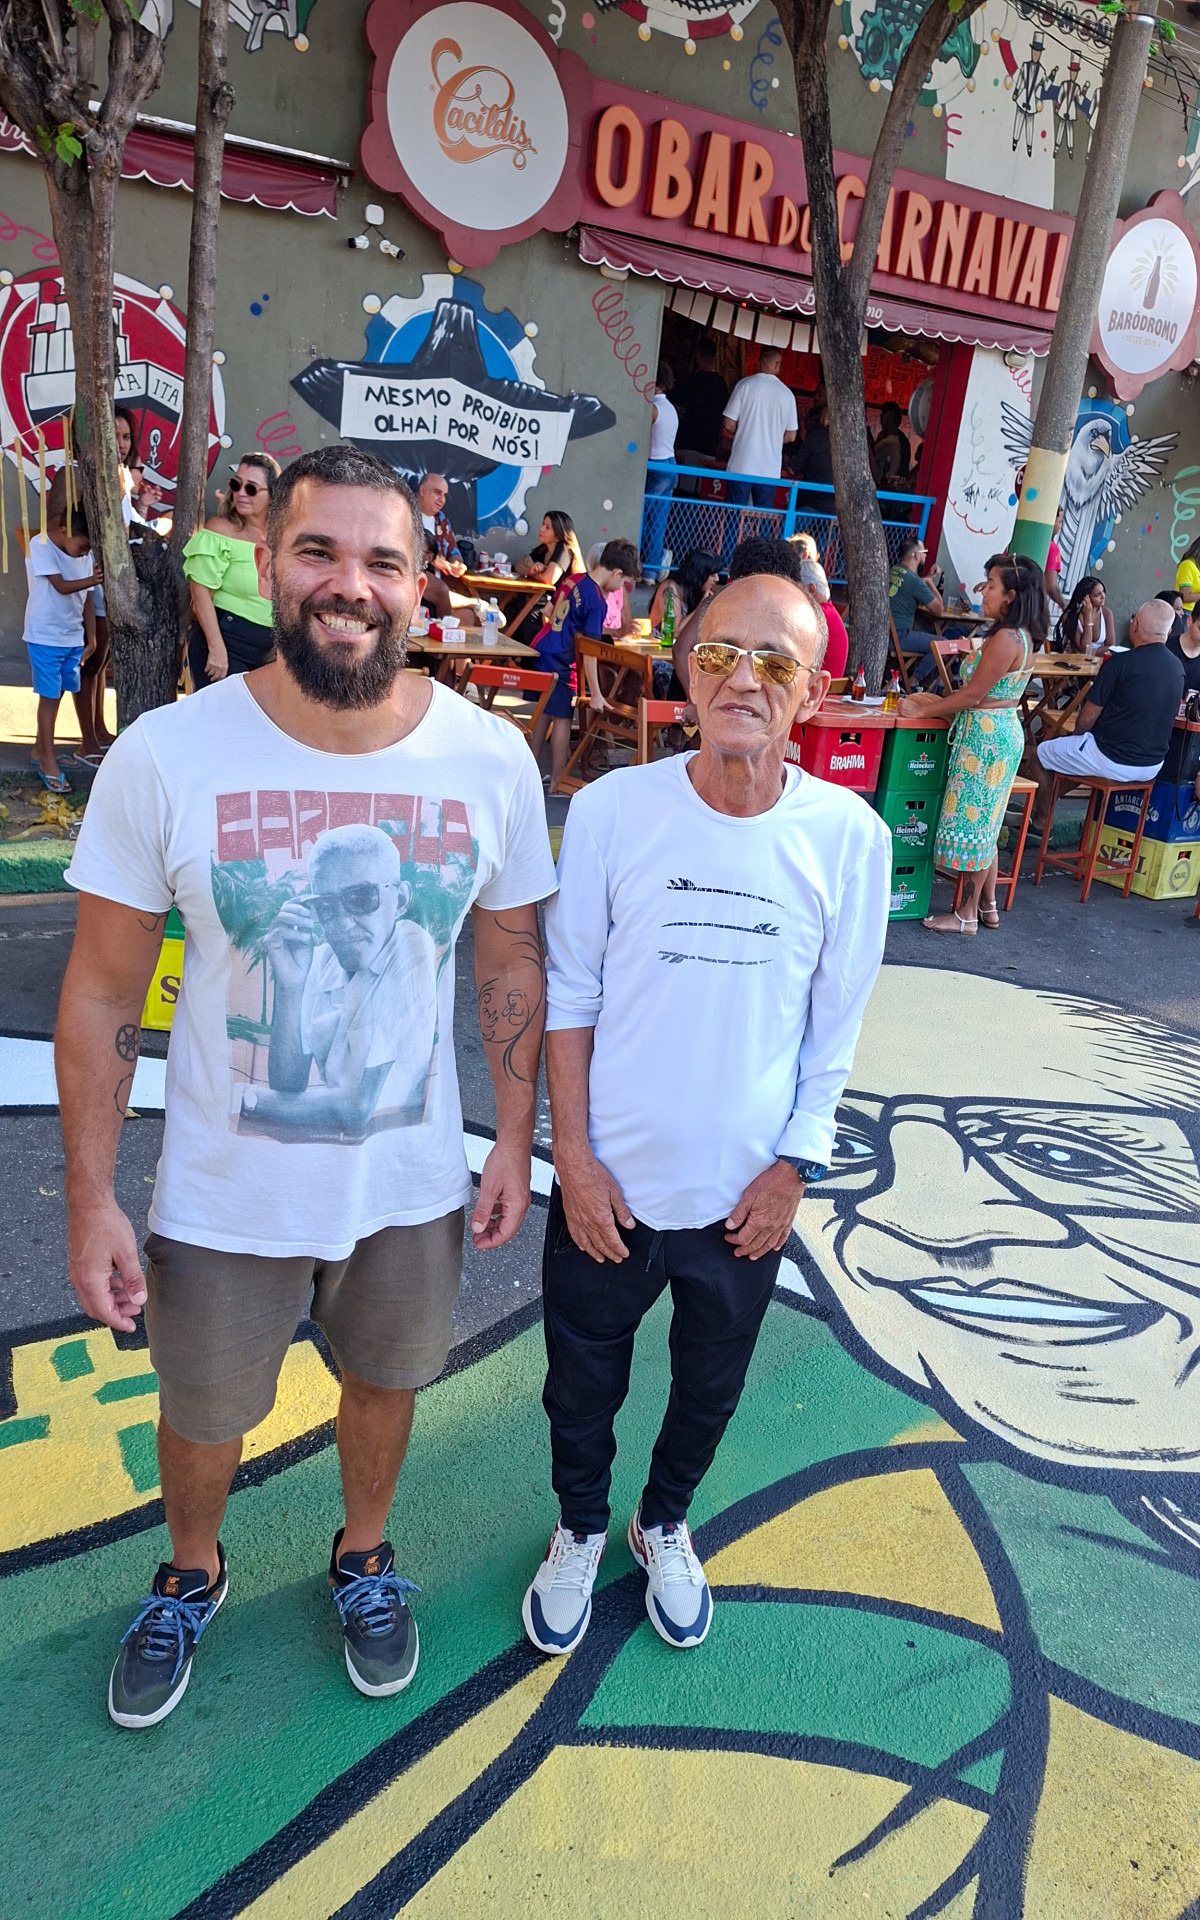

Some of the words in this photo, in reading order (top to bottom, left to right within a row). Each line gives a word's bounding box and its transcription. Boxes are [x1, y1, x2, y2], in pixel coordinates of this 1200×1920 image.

[431, 37, 538, 170] Cacildis
[592, 103, 645, 208] O
[647, 118, 775, 245] BAR
[1107, 309, 1178, 345] BARÓDROMO
[116, 373, 142, 392] TA
[153, 378, 180, 406] ITA
[364, 385, 451, 409] MESMO
[448, 417, 480, 445] POR
[491, 434, 540, 460] NÓS!
[829, 754, 866, 770] BRAHMA
